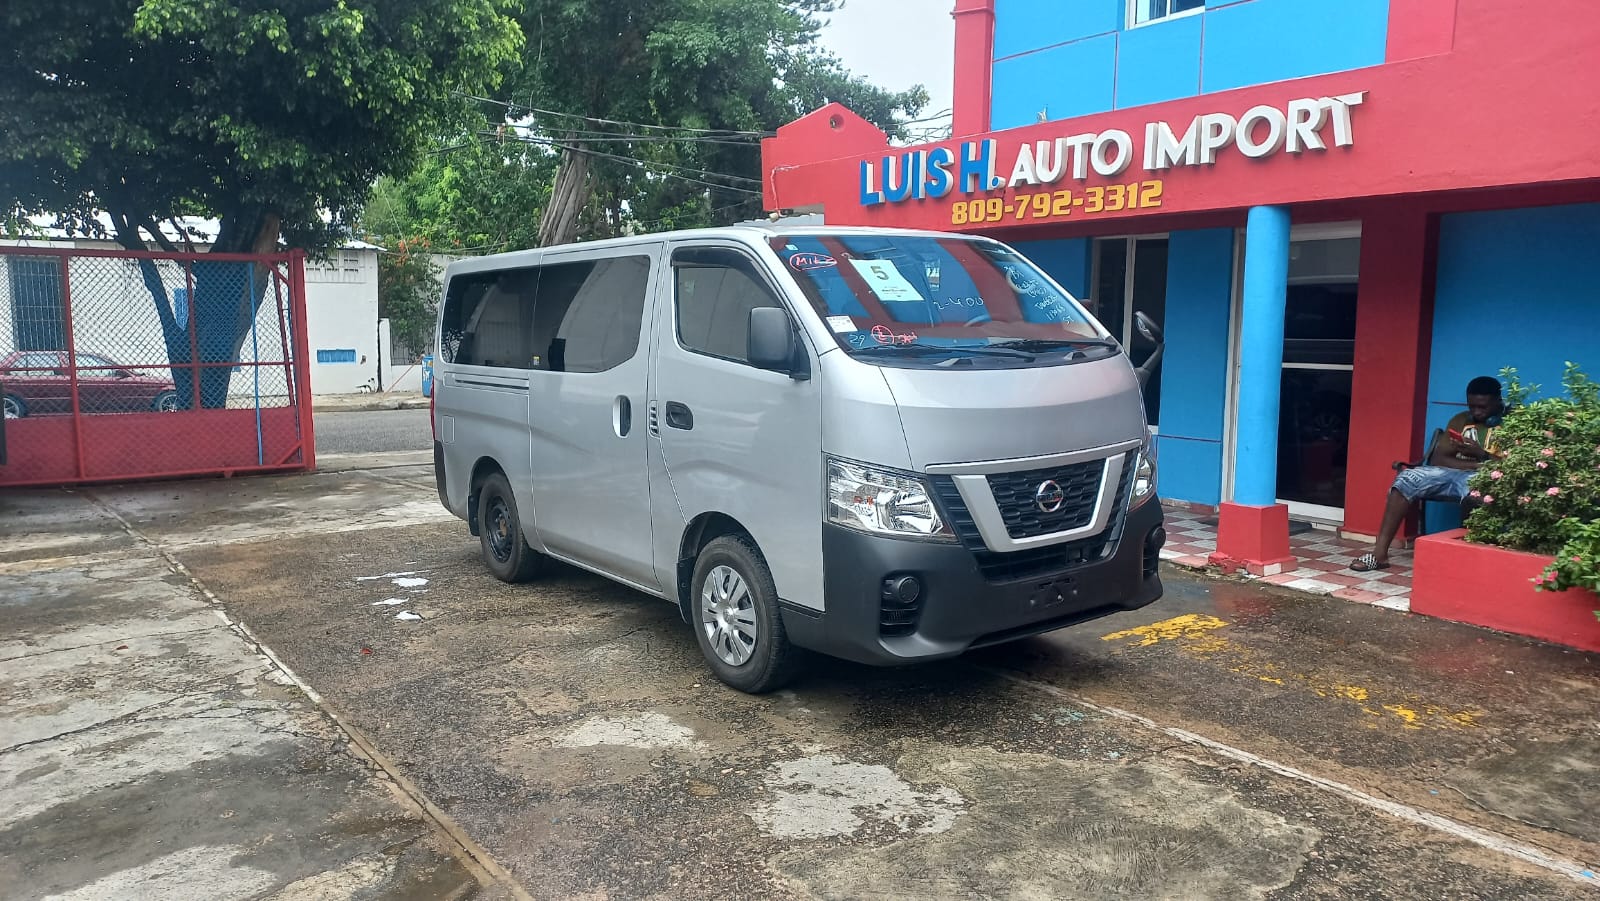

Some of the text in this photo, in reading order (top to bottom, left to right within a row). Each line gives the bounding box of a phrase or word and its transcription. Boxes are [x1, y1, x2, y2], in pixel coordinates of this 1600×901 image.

[861, 91, 1368, 205] LUIS H. AUTO IMPORT
[952, 180, 1163, 224] 809-792-3312
[870, 265, 889, 280] 5
